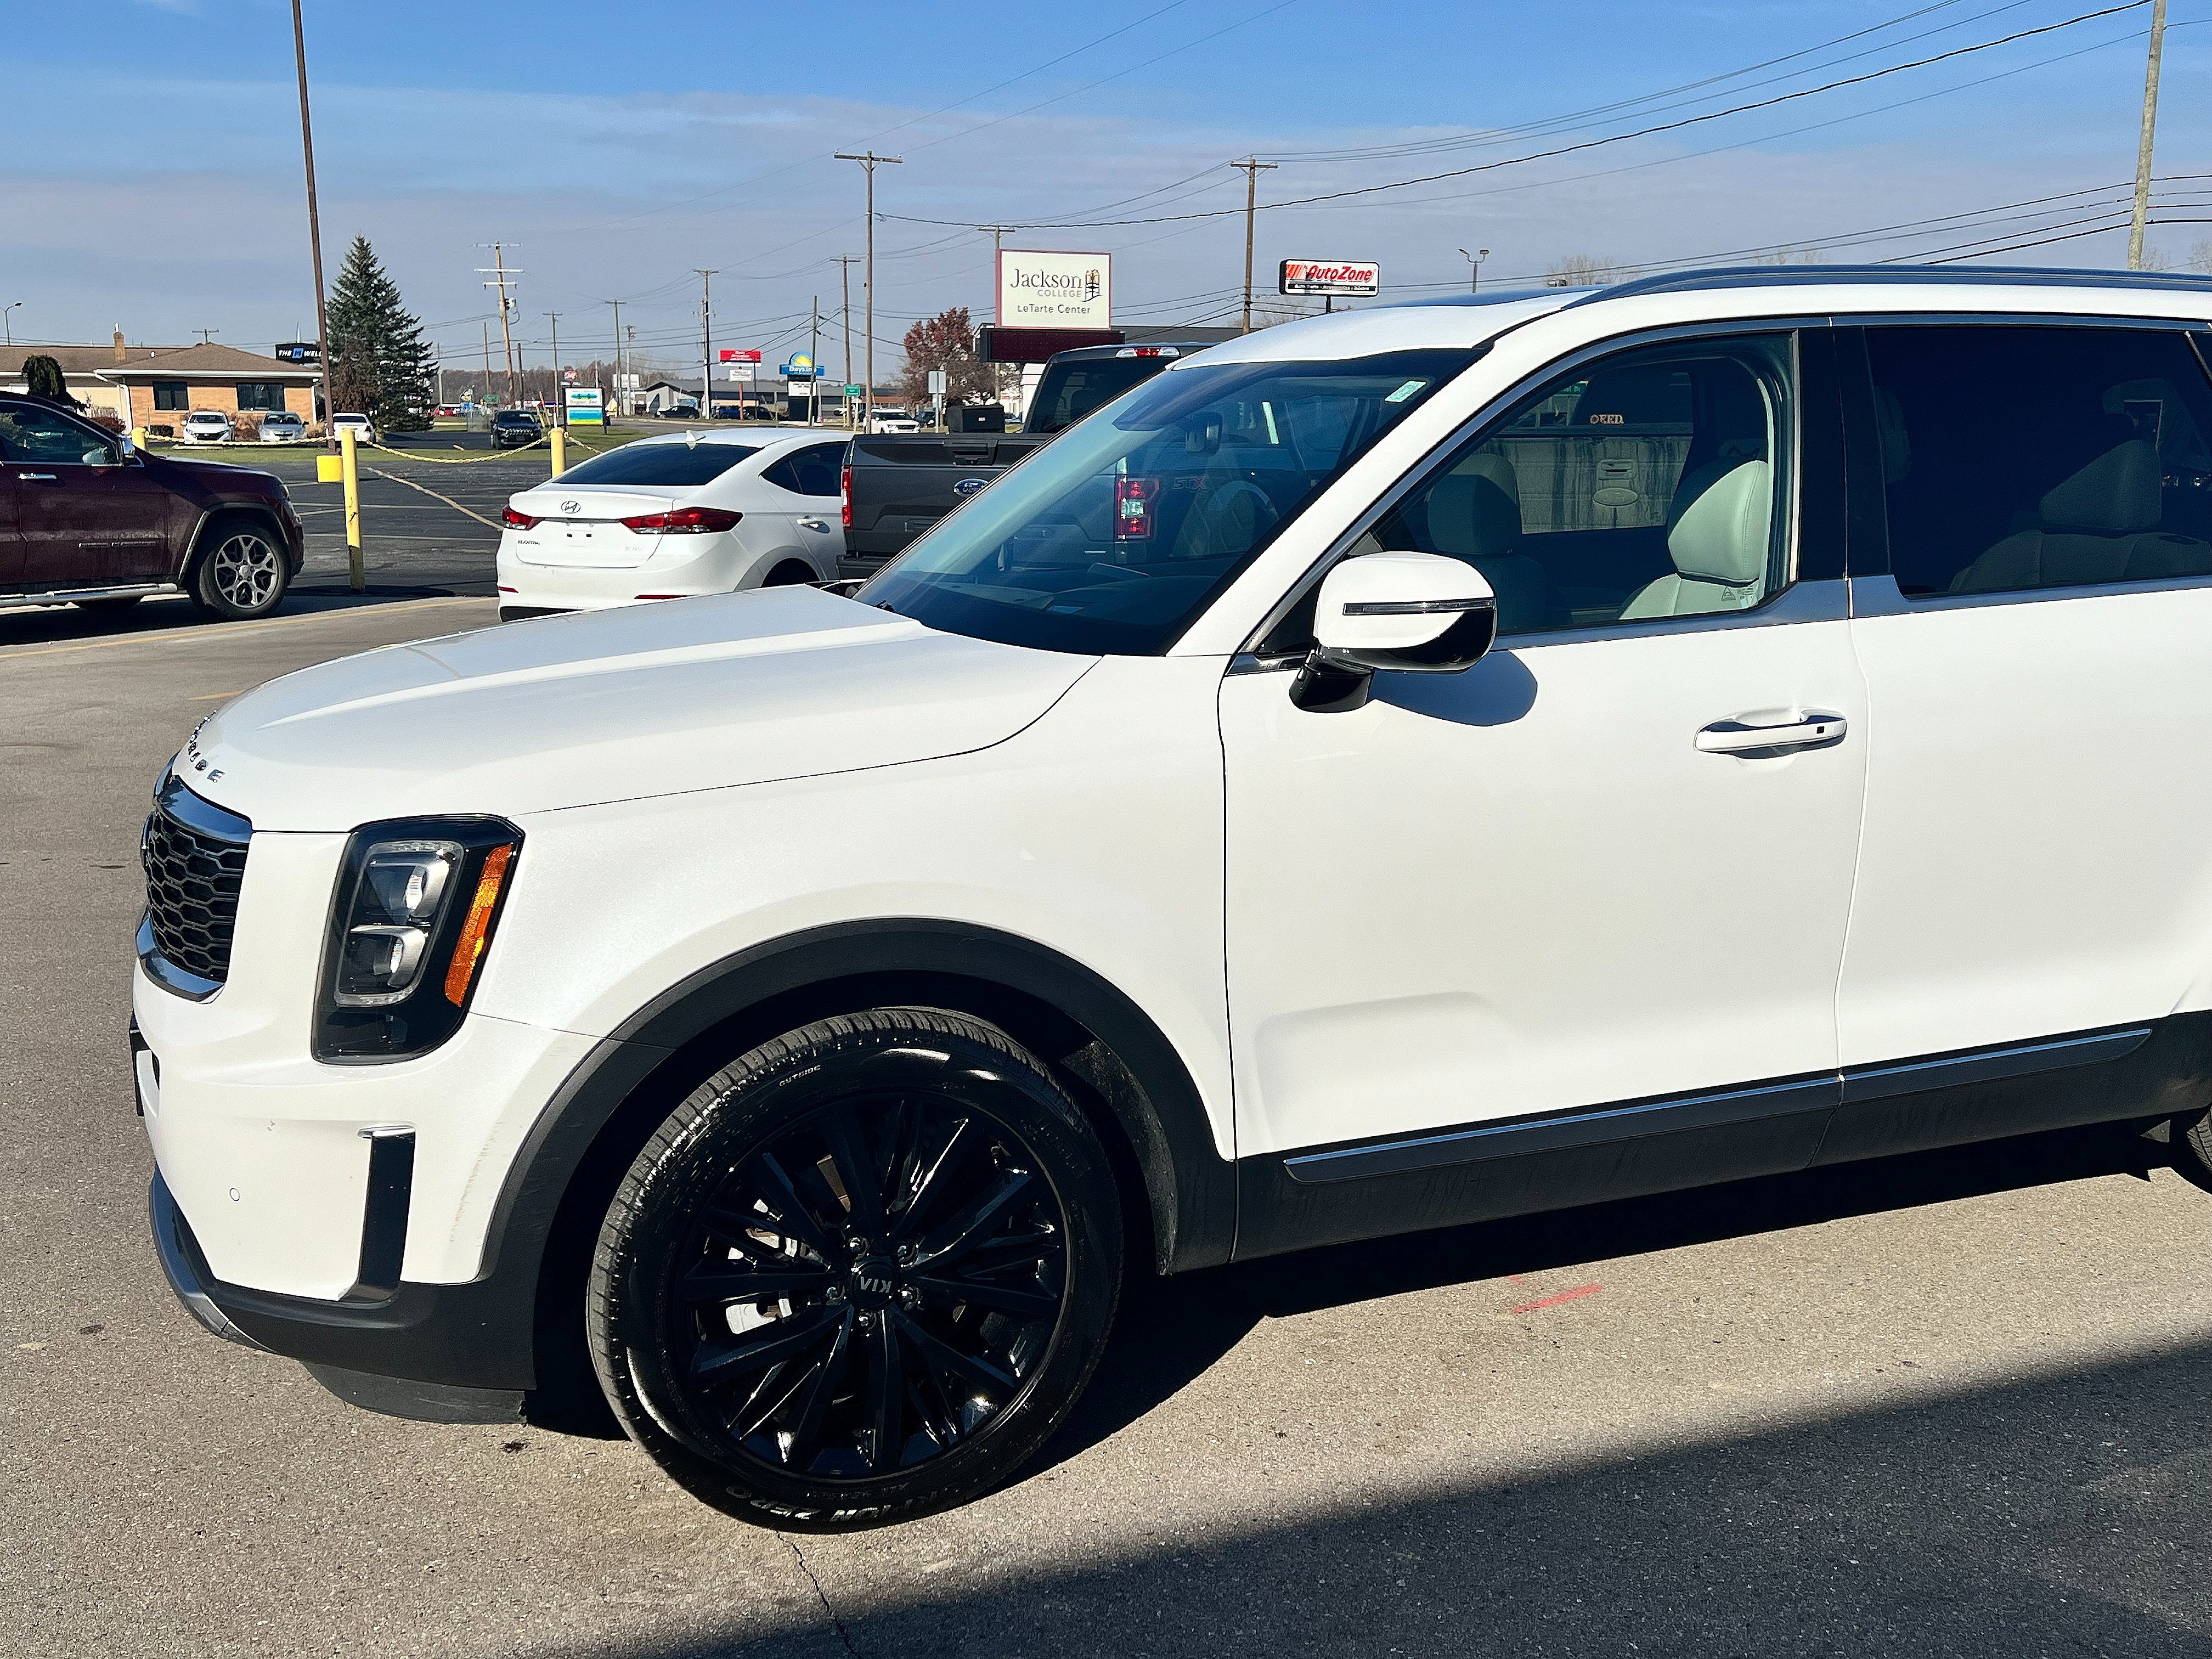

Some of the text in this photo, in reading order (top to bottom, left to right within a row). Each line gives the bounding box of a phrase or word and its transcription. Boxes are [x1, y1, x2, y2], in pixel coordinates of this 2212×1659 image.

[1010, 268, 1082, 288] Jackson
[1306, 266, 1373, 282] AutoZone
[1037, 289, 1081, 297] COLLEGE
[1017, 303, 1090, 313] LeTarte Center
[779, 1065, 821, 1086] OUTSIDE
[860, 1276, 892, 1293] KIA
